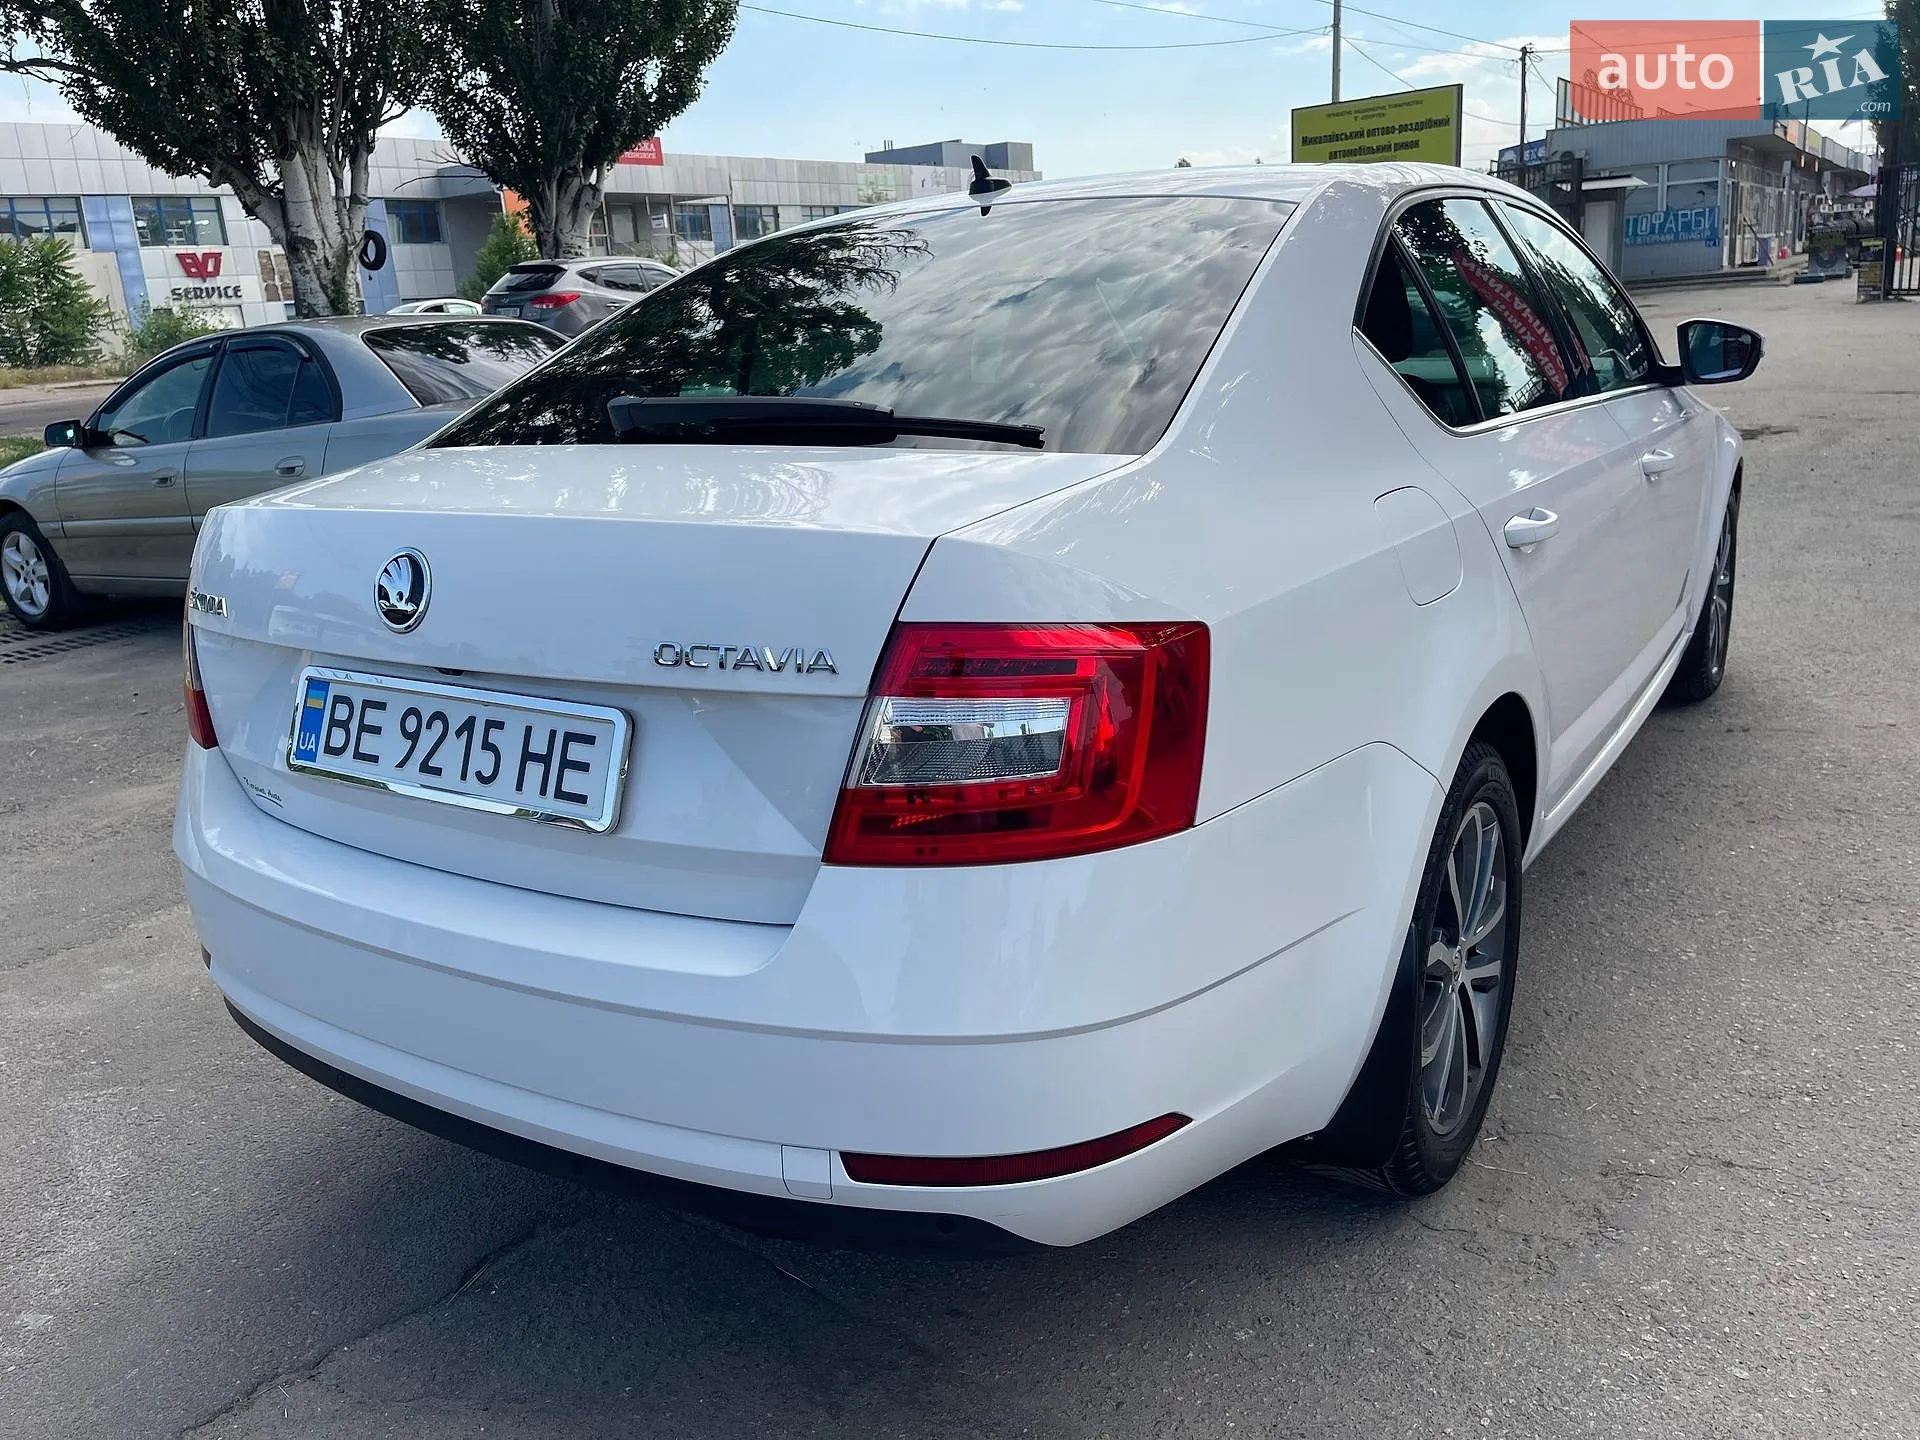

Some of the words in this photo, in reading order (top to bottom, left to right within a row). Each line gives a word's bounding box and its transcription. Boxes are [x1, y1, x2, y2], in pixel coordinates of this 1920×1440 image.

[1301, 127, 1365, 146] Миколаївський
[1366, 116, 1450, 138] оптово-роздрібний
[1328, 141, 1392, 160] автомобільний
[1393, 139, 1420, 152] ринок
[171, 285, 242, 301] SERVICE
[653, 641, 839, 674] OCTAVIA
[298, 730, 316, 753] UA
[323, 694, 388, 764] BE
[394, 706, 506, 786] 9215
[515, 725, 597, 805] HE
